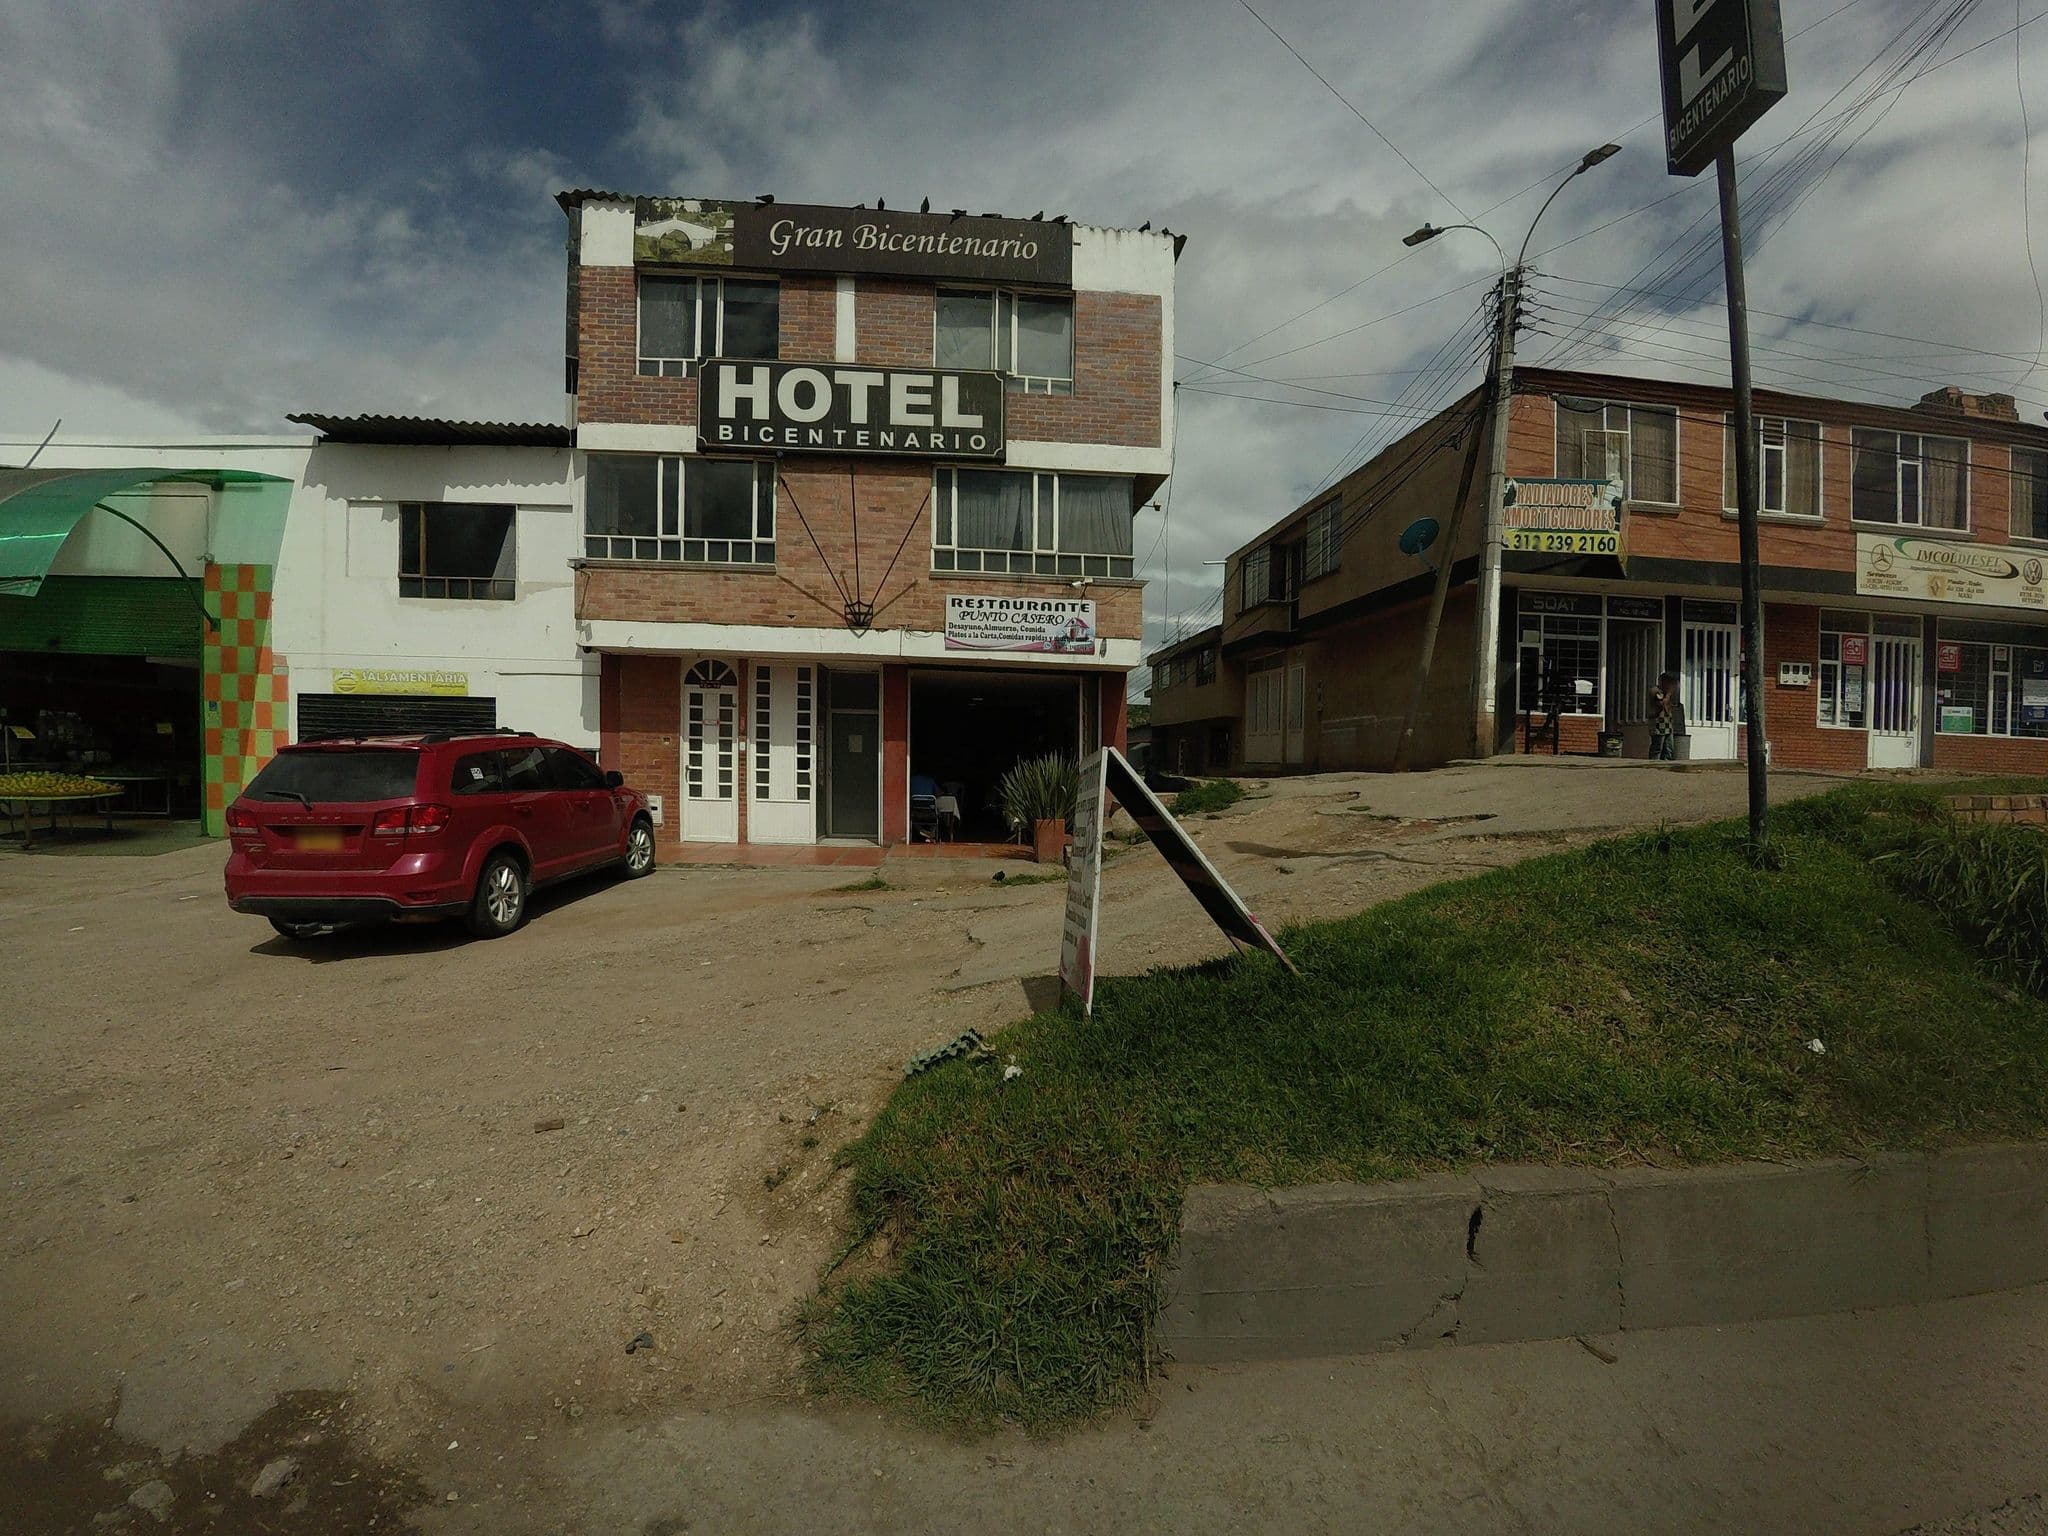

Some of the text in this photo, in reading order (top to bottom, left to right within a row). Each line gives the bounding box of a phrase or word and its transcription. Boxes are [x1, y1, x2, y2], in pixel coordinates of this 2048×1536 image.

[1670, 55, 1749, 151] BICENTENARIO
[769, 219, 1038, 260] Gran Bicentenario
[718, 365, 984, 428] HOTEL
[719, 425, 987, 450] BICENTENARIO
[1516, 483, 1606, 507] RADIADORES Y
[1503, 506, 1616, 531] AMORTIGUADORES
[1547, 535, 1574, 553] 239
[1578, 536, 1616, 553] 2160
[1916, 549, 2001, 569] IMCOLDIESEL
[951, 597, 1090, 613] RESTAURANTE
[1532, 597, 1577, 612] SOAT
[959, 610, 1064, 626] PUNTO CASERO
[1020, 625, 1046, 633] Comida
